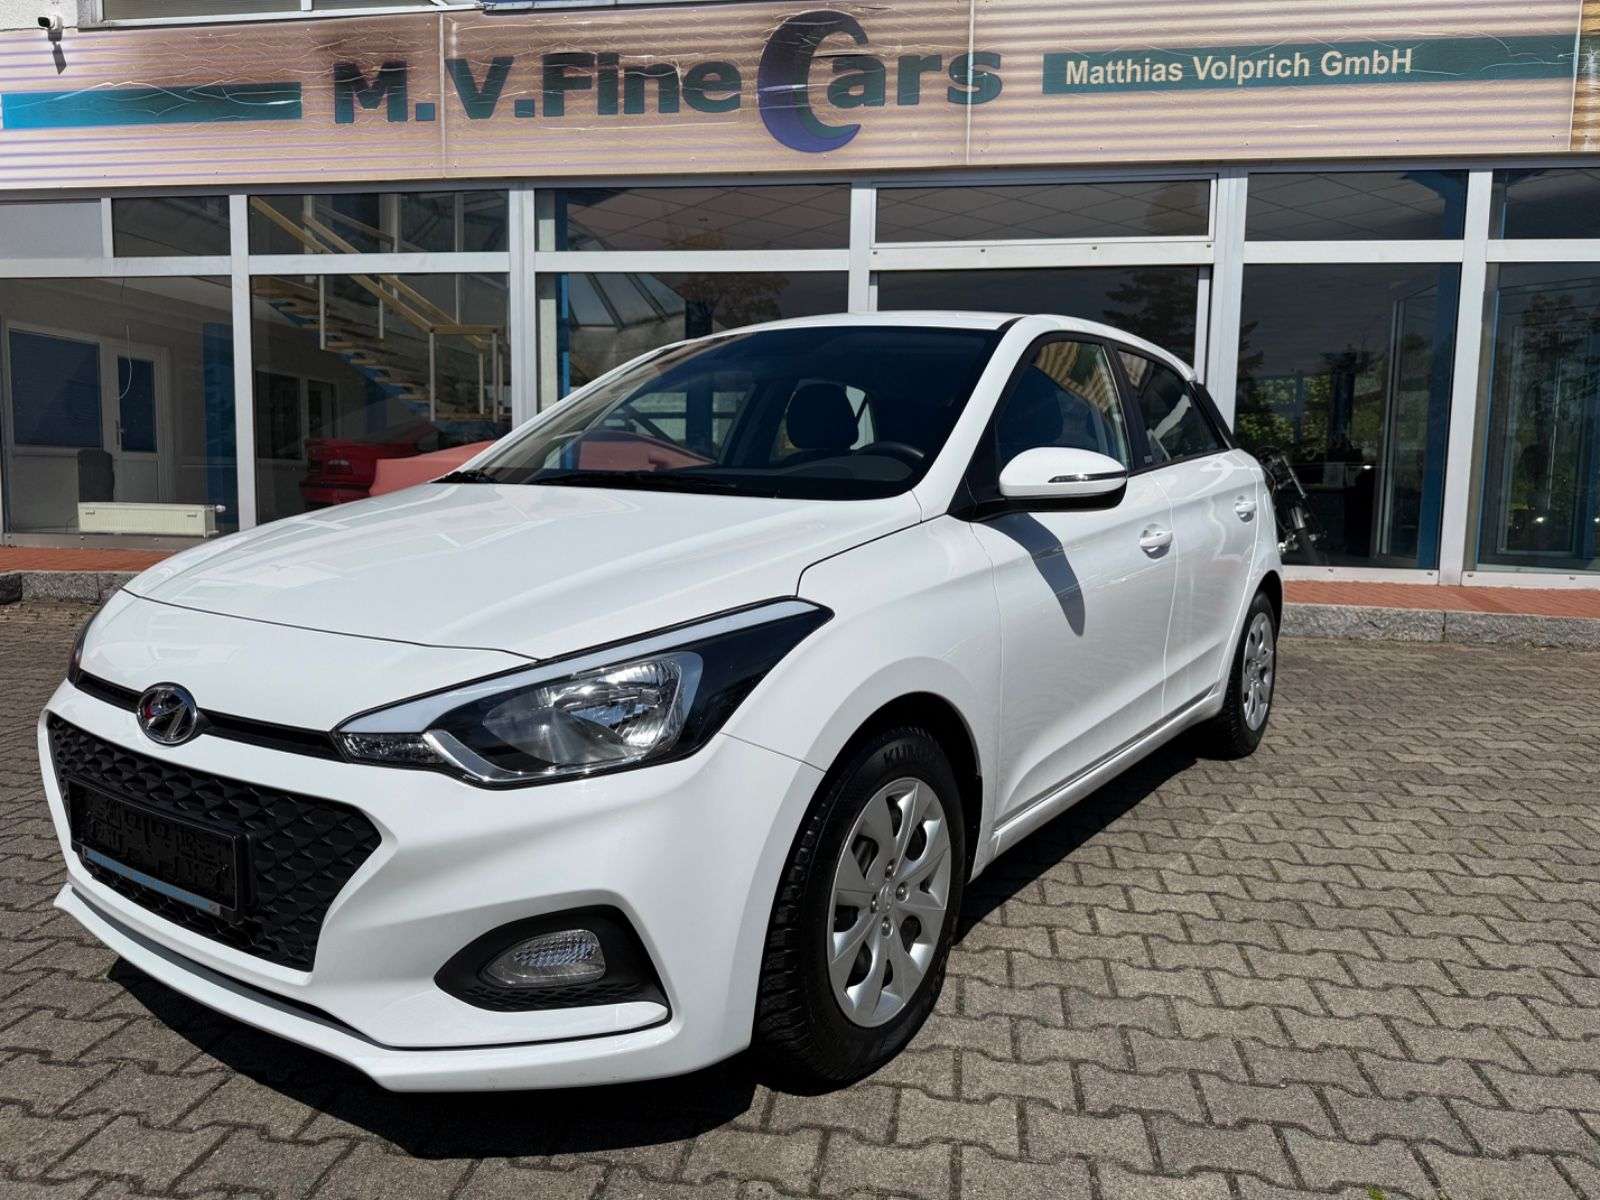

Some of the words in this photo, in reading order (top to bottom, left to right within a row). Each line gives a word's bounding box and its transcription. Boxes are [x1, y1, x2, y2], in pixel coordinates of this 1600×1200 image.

[757, 9, 1004, 154] Cars
[1065, 58, 1184, 85] Matthias
[1192, 52, 1311, 85] Volprich
[1320, 48, 1413, 77] GmbH
